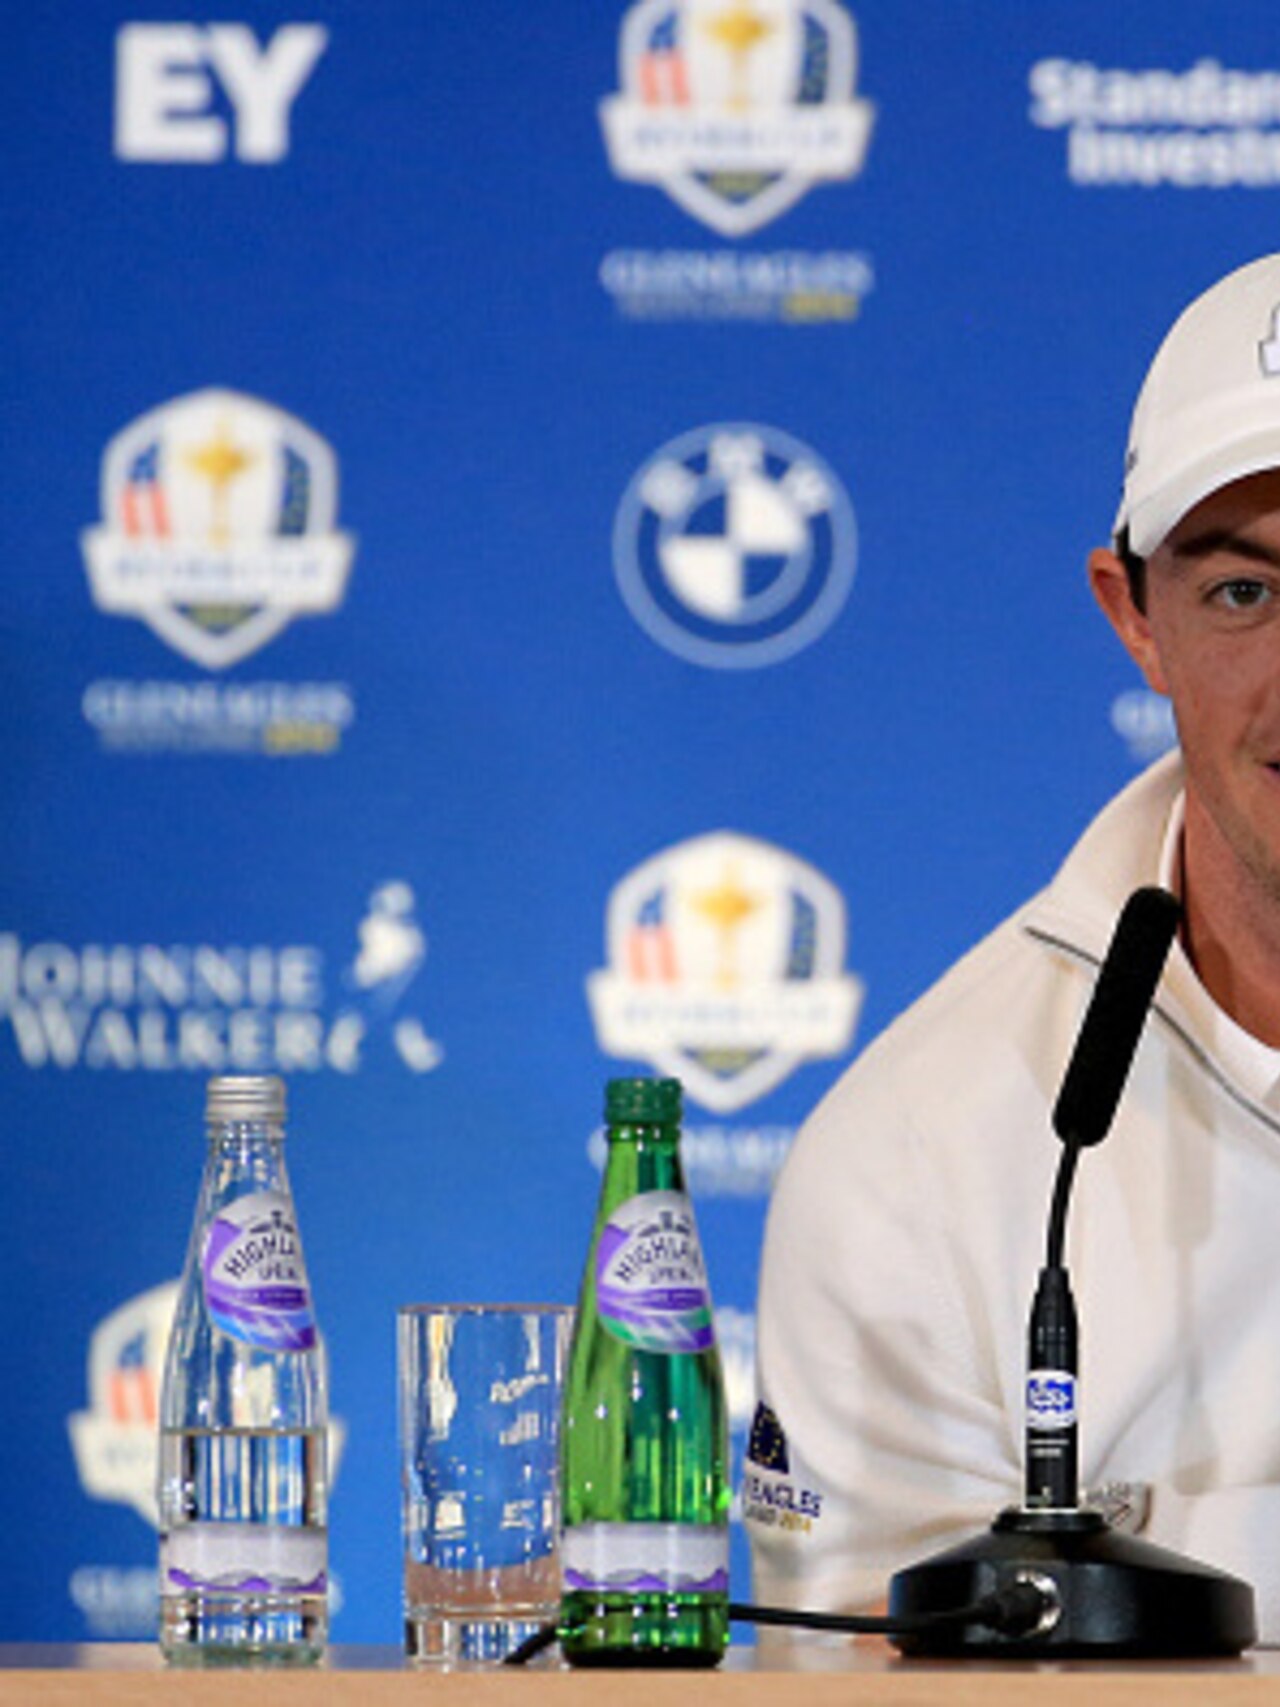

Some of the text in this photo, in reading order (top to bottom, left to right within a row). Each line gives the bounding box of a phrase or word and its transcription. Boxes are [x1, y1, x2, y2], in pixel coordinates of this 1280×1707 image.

[115, 24, 328, 163] EY
[8, 998, 323, 1070] WALKER
[742, 1476, 822, 1518] EAGLES
